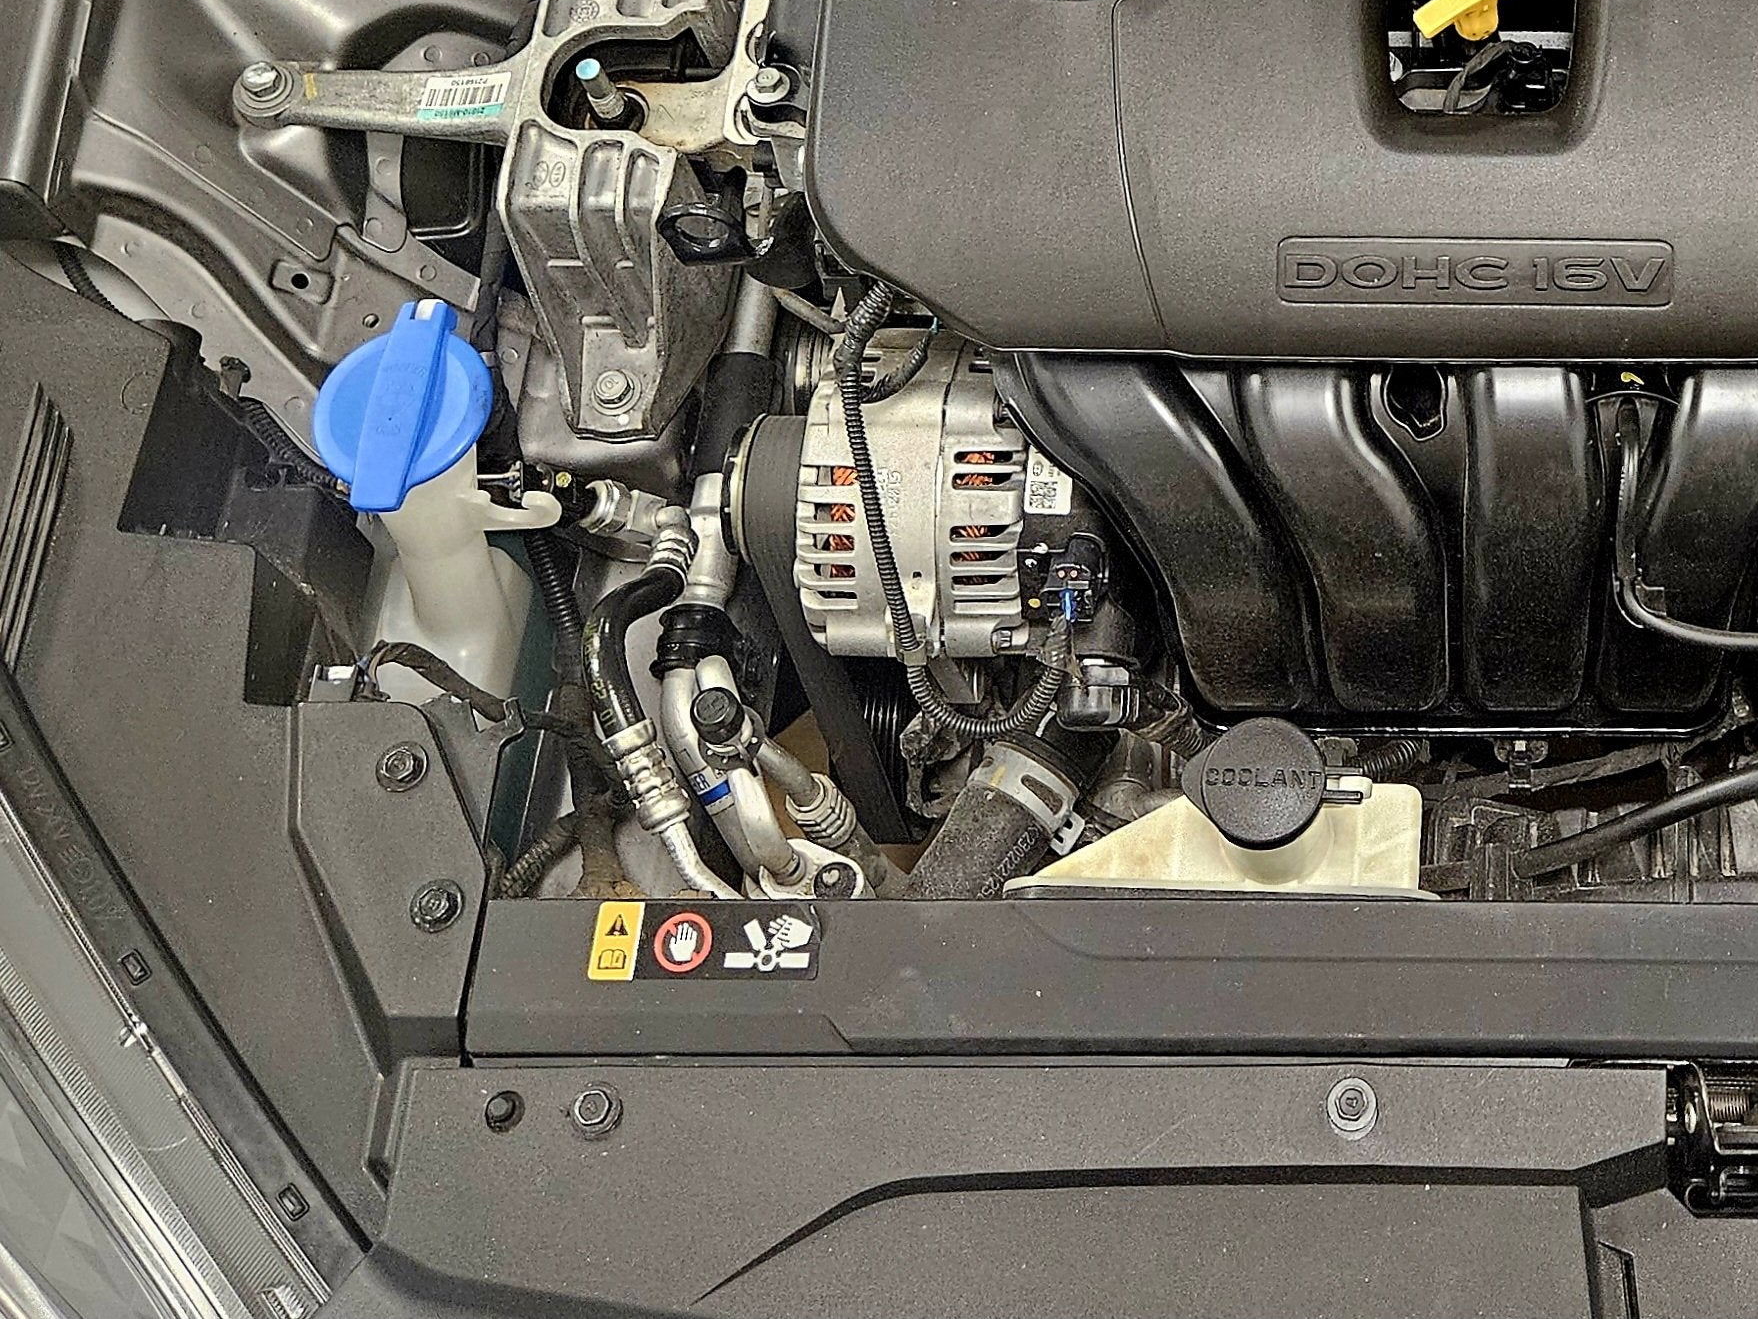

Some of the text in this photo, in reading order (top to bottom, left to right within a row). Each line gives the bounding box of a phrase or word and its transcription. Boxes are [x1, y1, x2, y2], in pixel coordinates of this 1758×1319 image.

[1284, 254, 1666, 293] DOHC 16V
[1204, 767, 1322, 791] COOLANT
